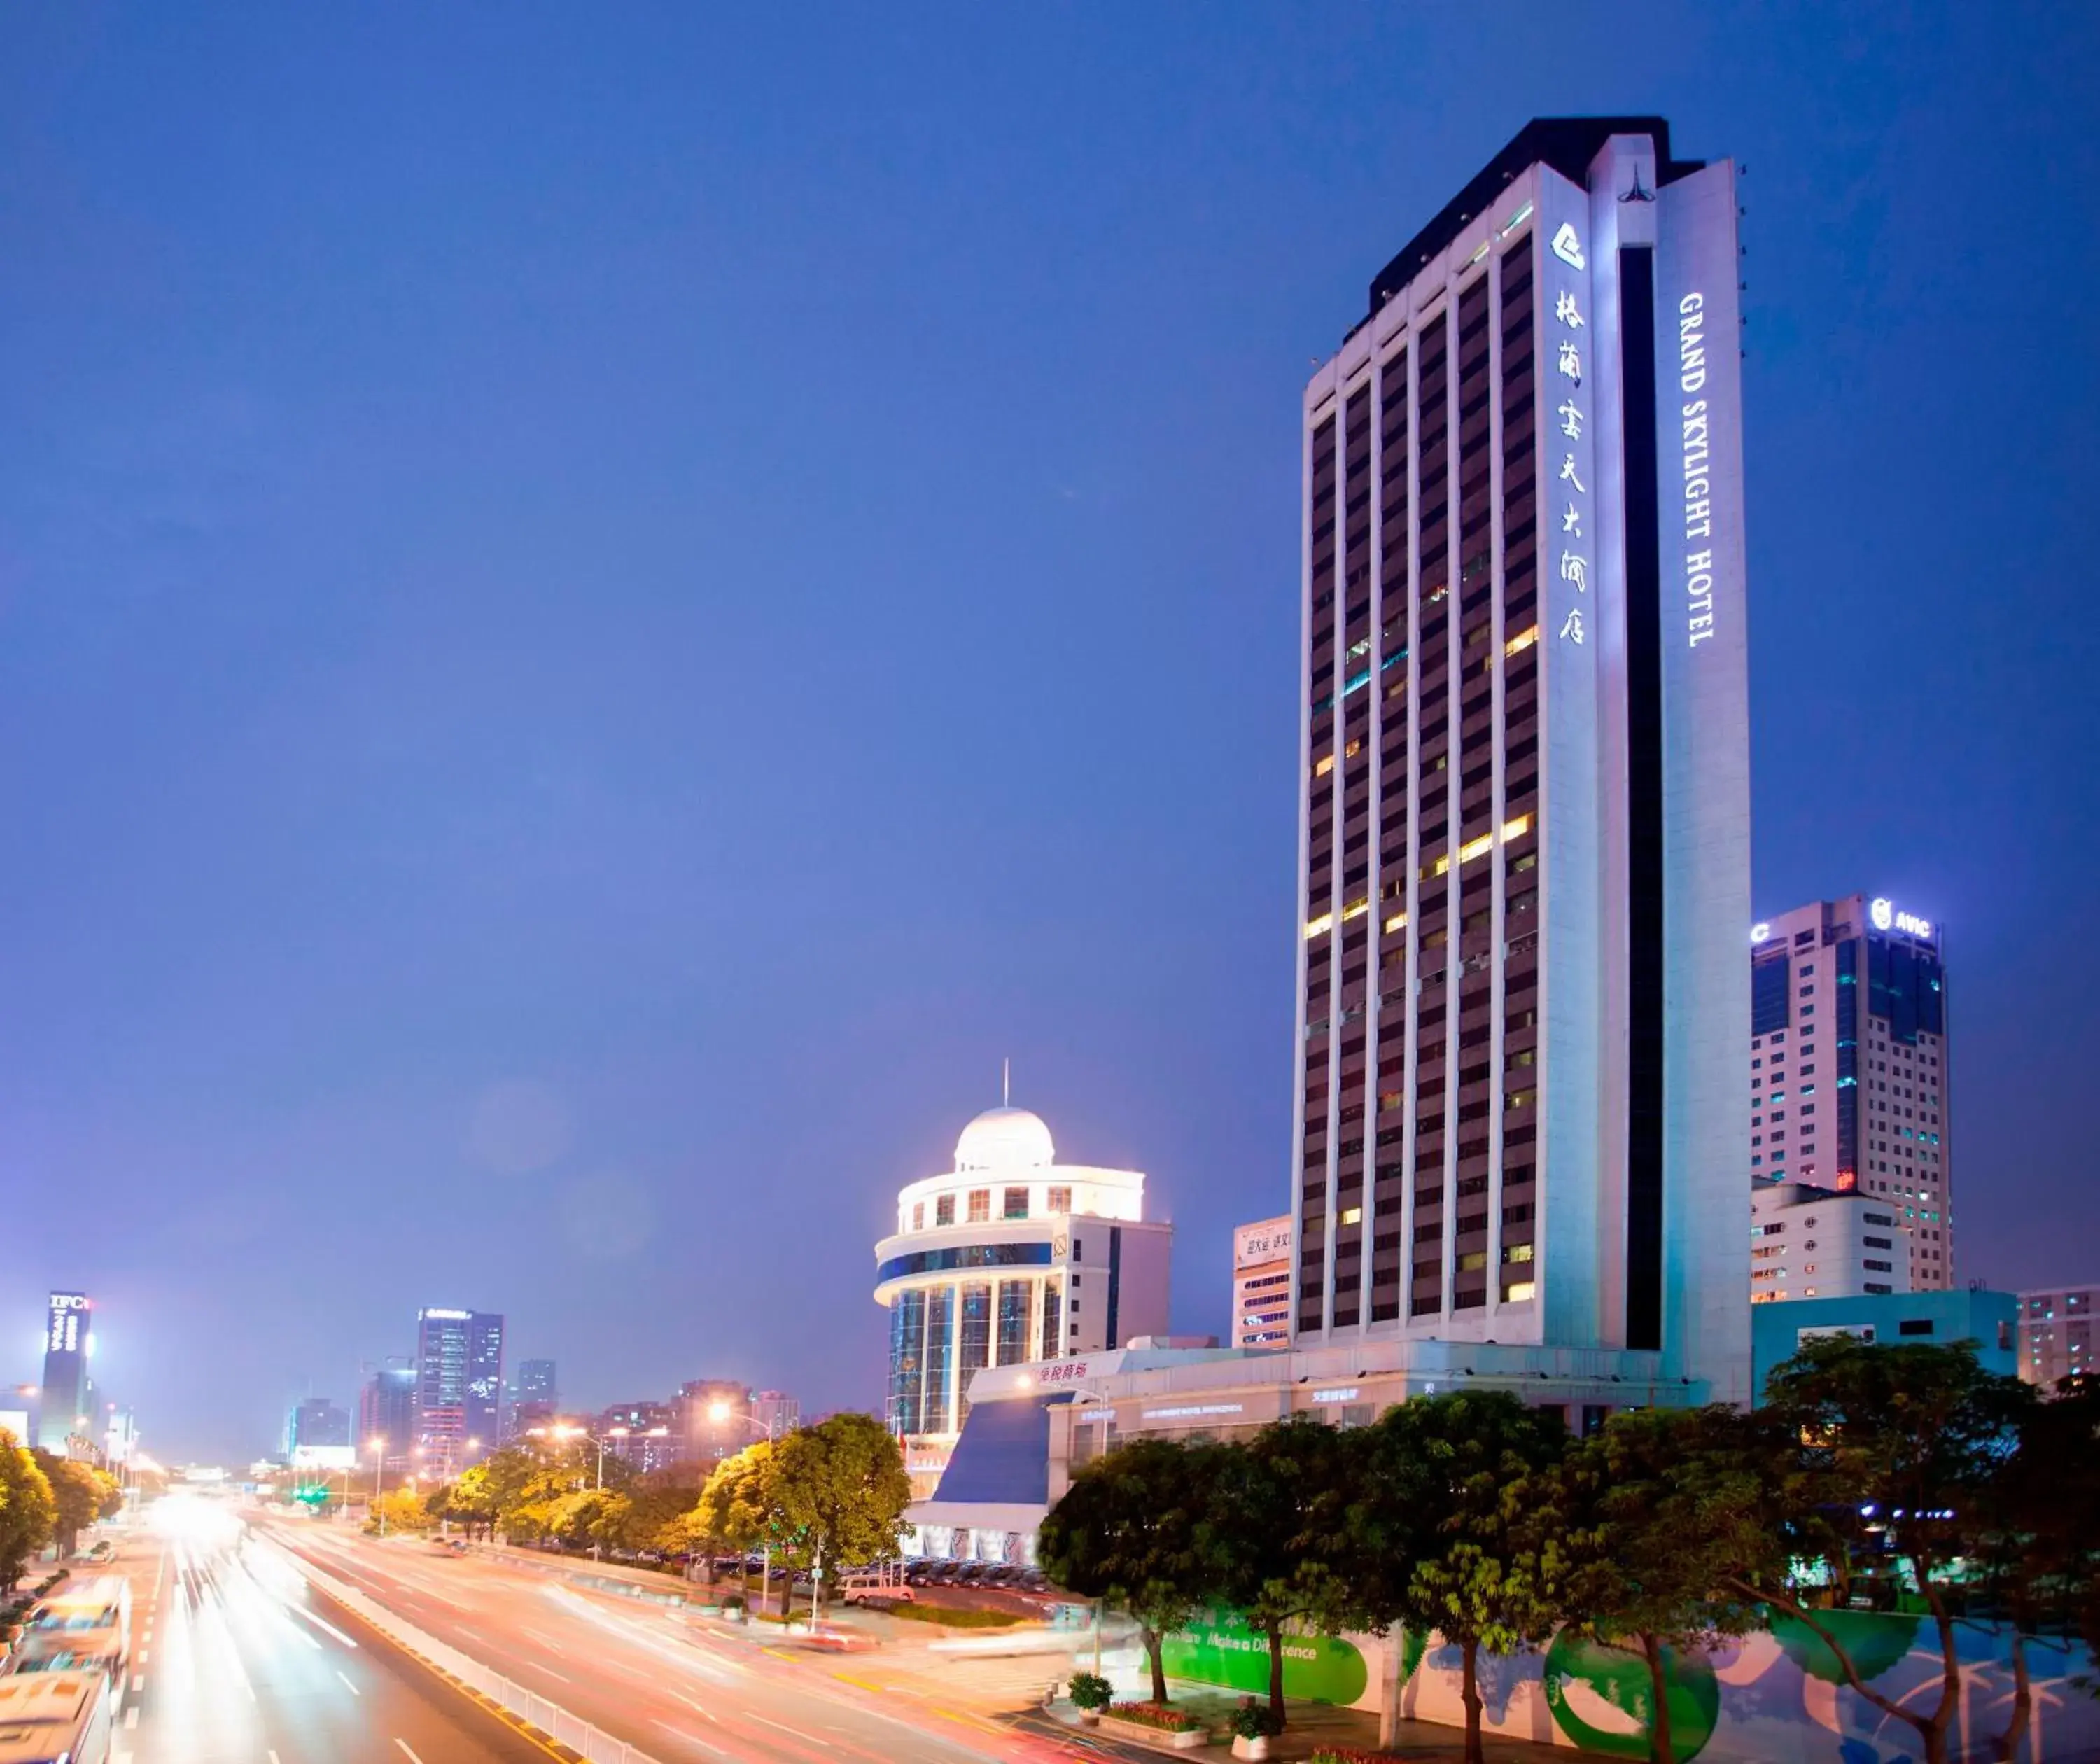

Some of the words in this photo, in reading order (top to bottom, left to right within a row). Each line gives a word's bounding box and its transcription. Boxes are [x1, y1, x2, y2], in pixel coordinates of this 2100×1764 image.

[1679, 292, 1706, 393] GRAND
[1681, 400, 1710, 539] SKYLIGHT
[1686, 549, 1713, 648] HOTEL
[1895, 911, 1930, 937] AVIC
[1252, 1636, 1317, 1661] Difrence
